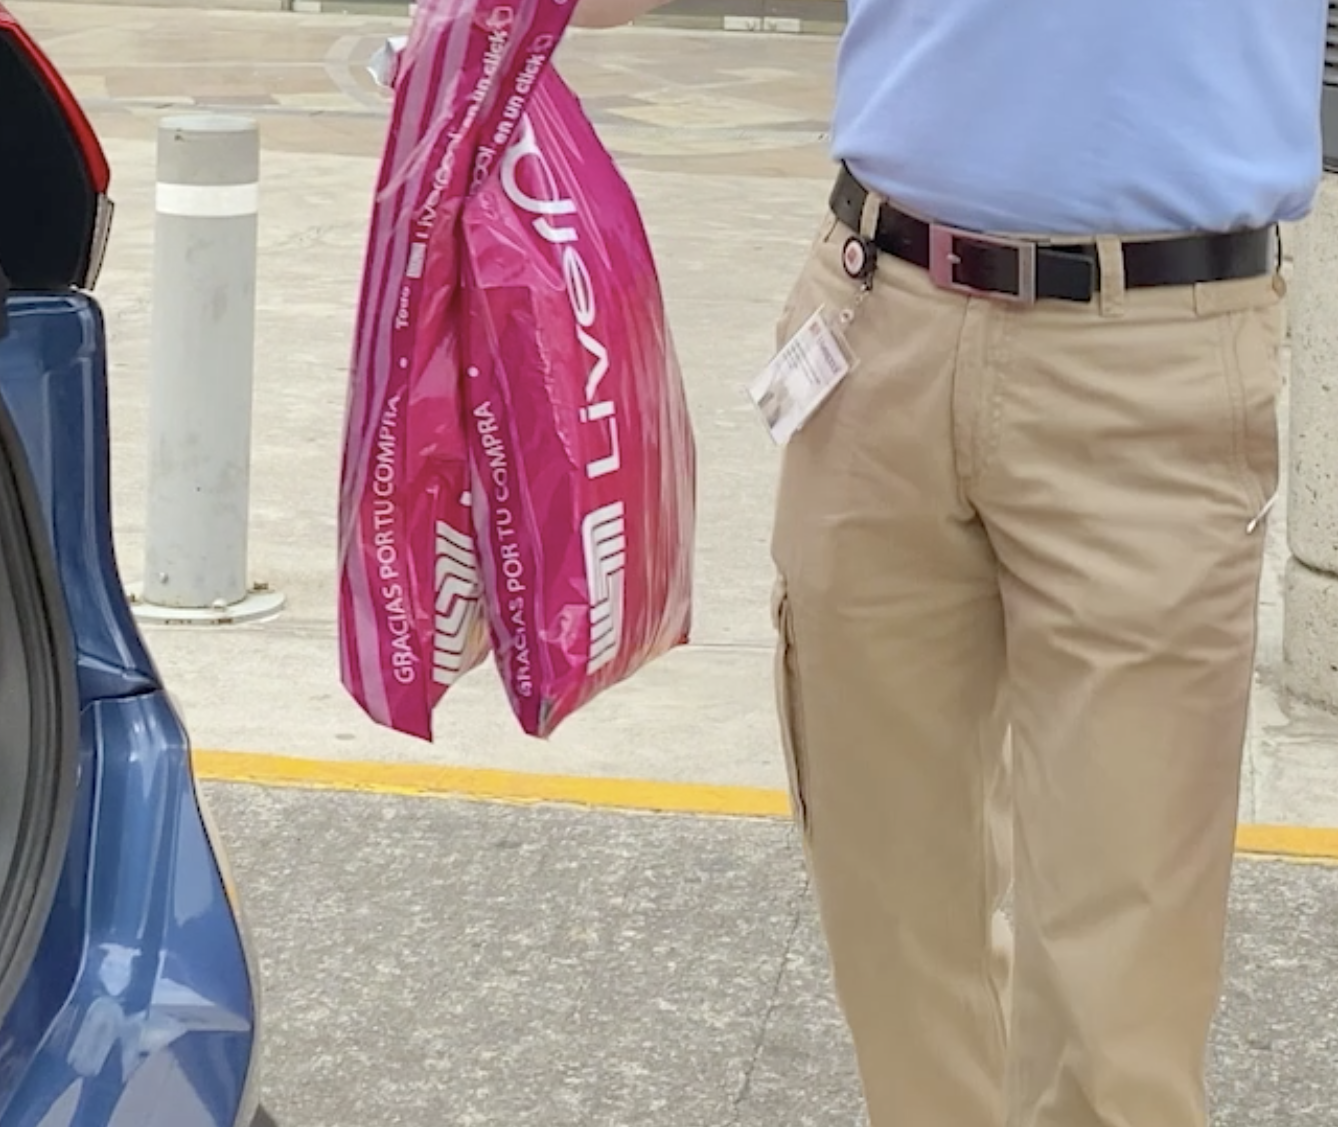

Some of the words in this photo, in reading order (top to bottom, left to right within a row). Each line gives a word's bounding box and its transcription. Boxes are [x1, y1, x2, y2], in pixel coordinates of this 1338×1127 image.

[503, 95, 525, 119] un
[473, 400, 510, 502] COMPRA
[373, 500, 395, 531] TU
[495, 507, 515, 542] TU
[374, 530, 400, 580] POR
[500, 542, 527, 593] POR
[381, 583, 419, 684] GRACIAS
